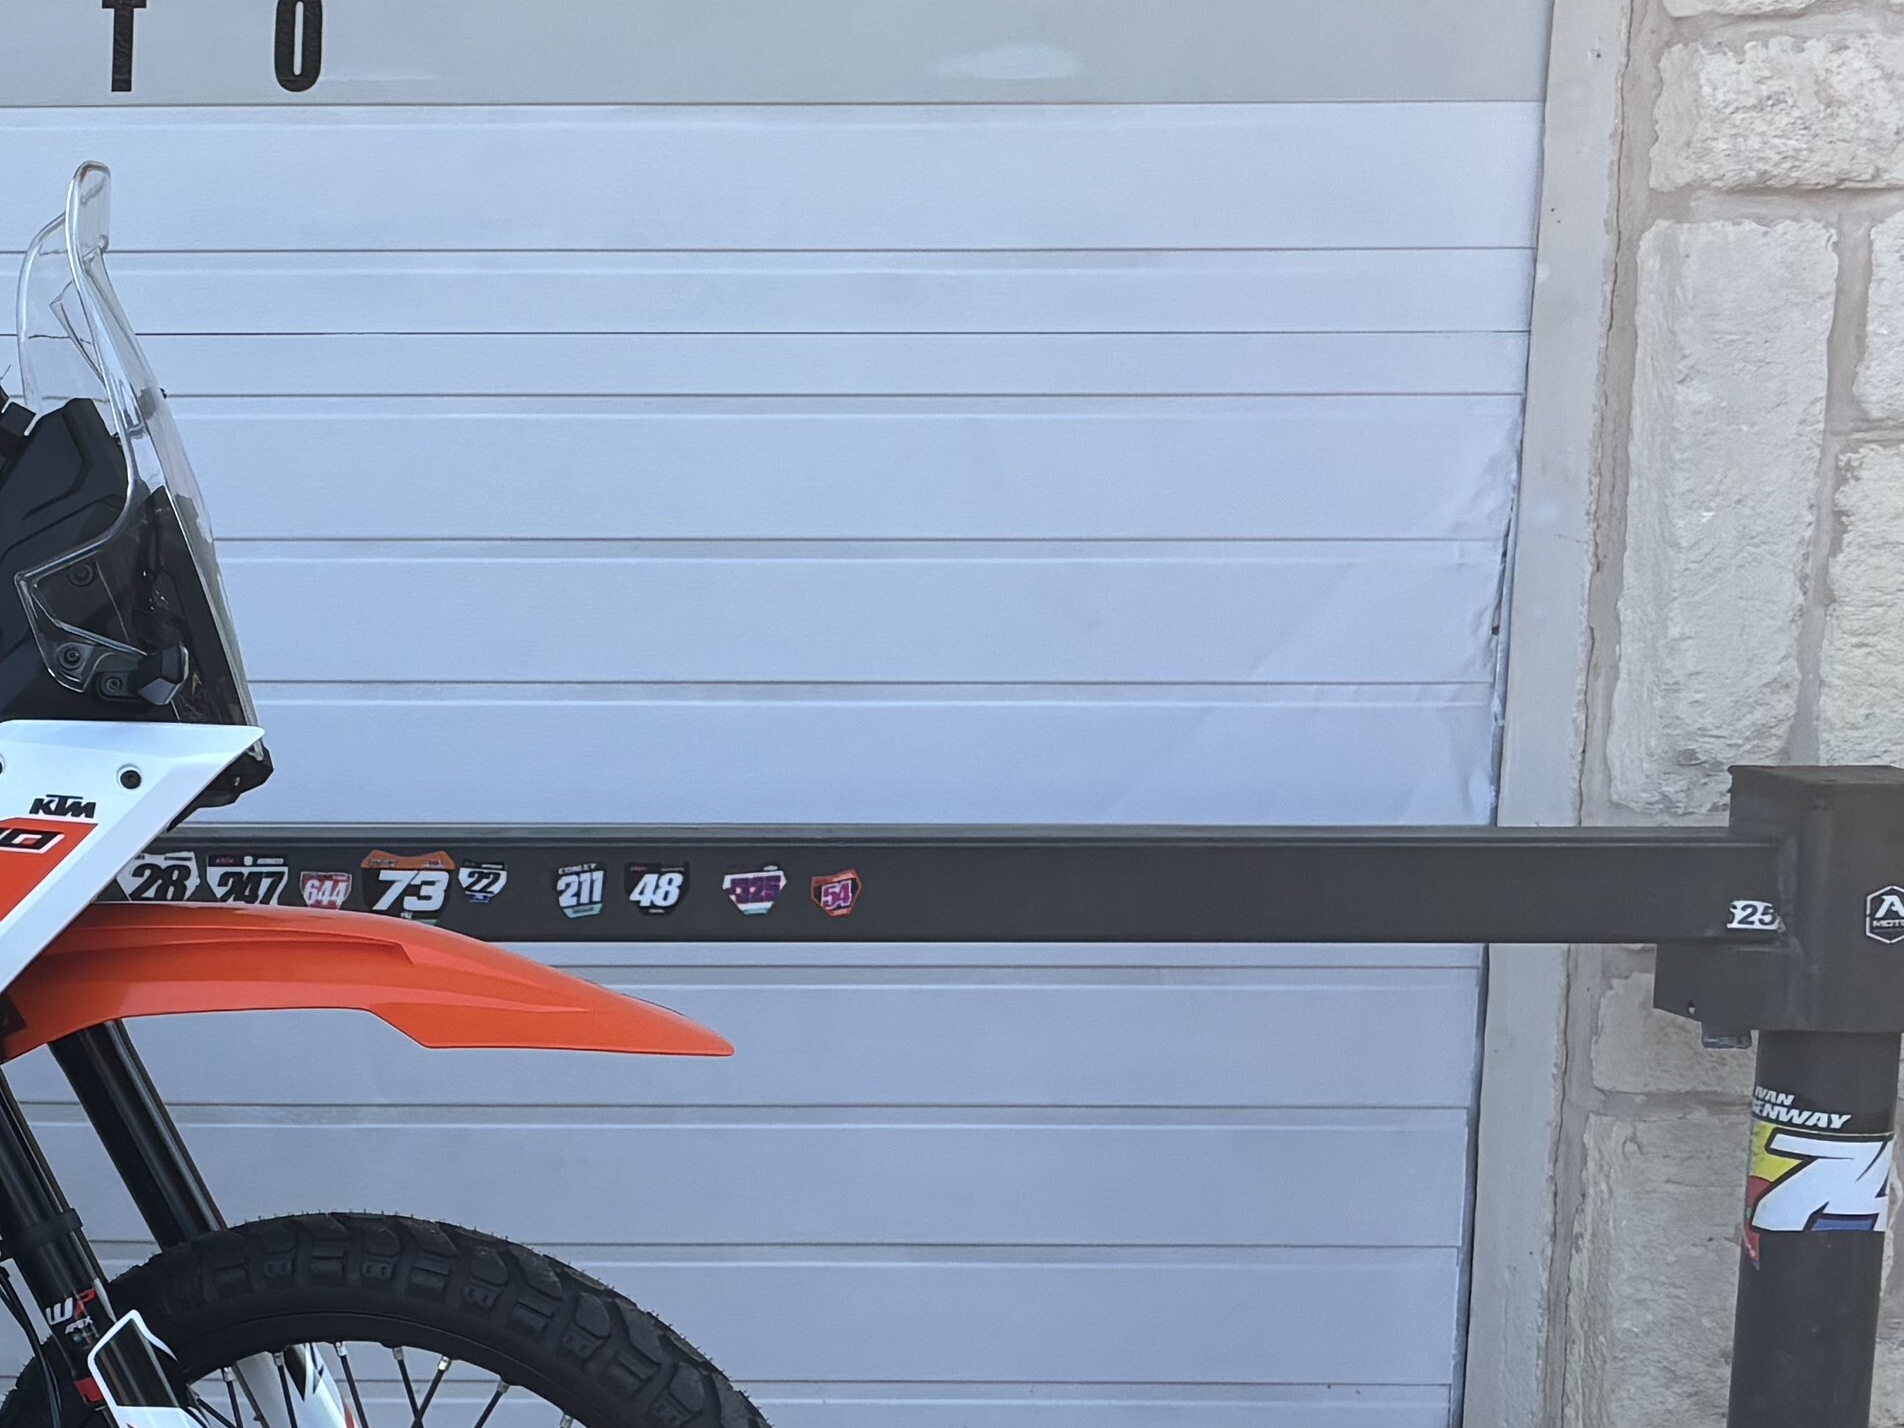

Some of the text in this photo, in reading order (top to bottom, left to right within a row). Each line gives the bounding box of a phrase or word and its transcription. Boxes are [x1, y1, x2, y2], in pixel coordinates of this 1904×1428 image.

[30, 794, 96, 818] KTM
[130, 864, 192, 901] 28
[217, 871, 286, 904] 247
[303, 880, 349, 905] 644
[372, 870, 450, 911] 73
[463, 871, 500, 893] 22
[556, 871, 604, 907] 211
[629, 873, 683, 906] 48
